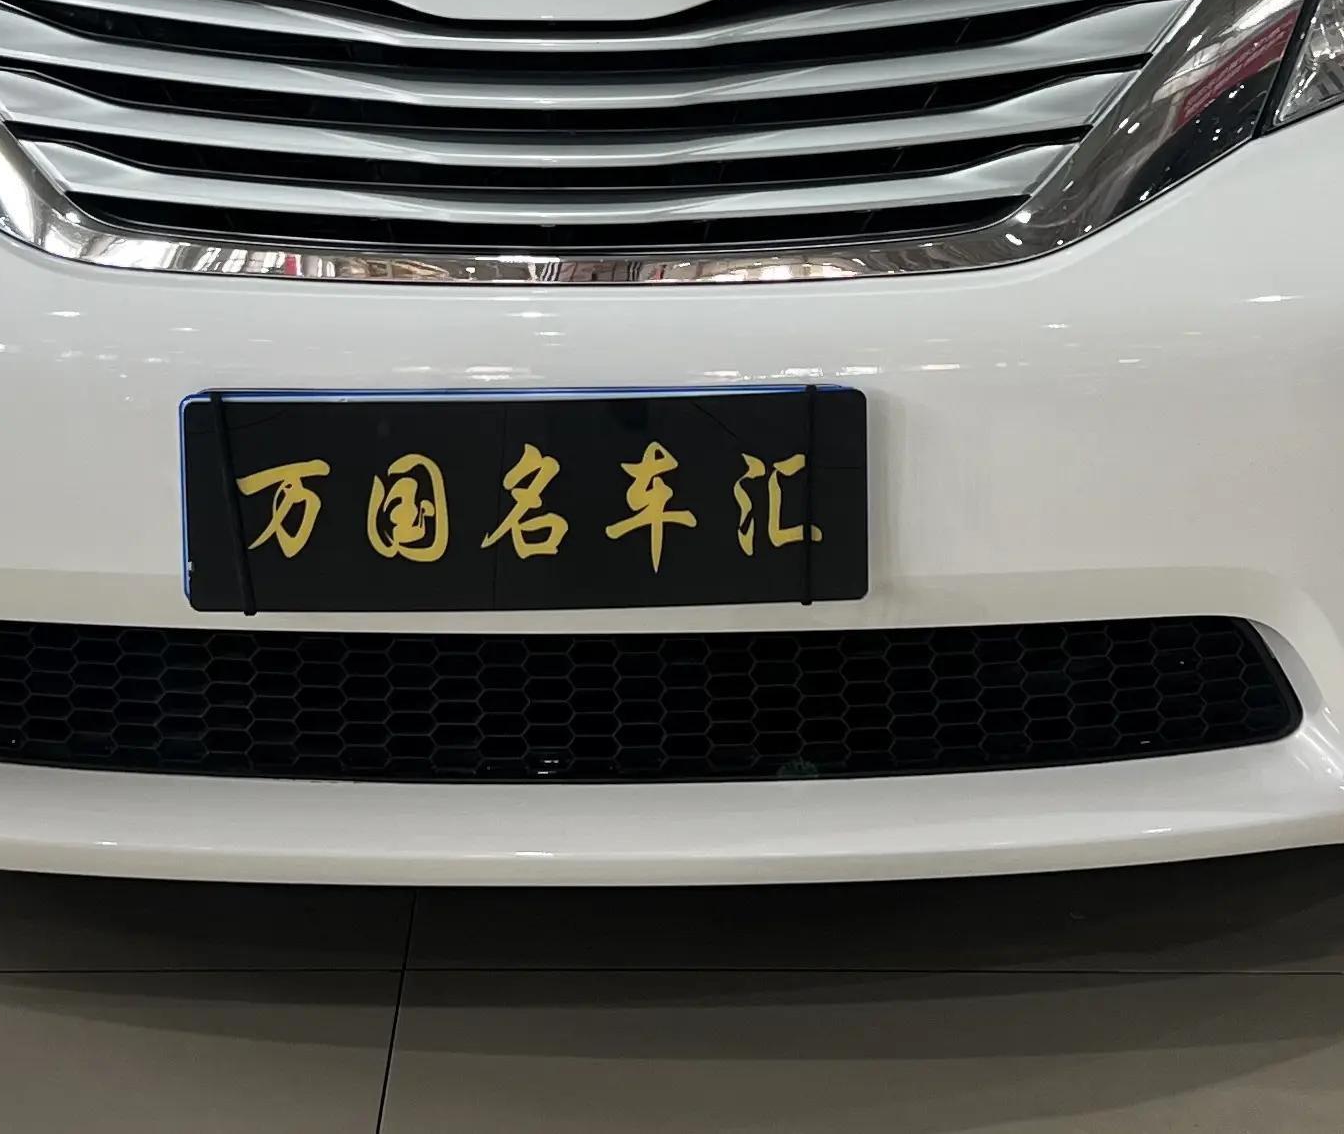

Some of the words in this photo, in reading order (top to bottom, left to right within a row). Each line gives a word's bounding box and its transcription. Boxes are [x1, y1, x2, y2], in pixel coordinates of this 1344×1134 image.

[237, 441, 824, 574] 万国名车汇
